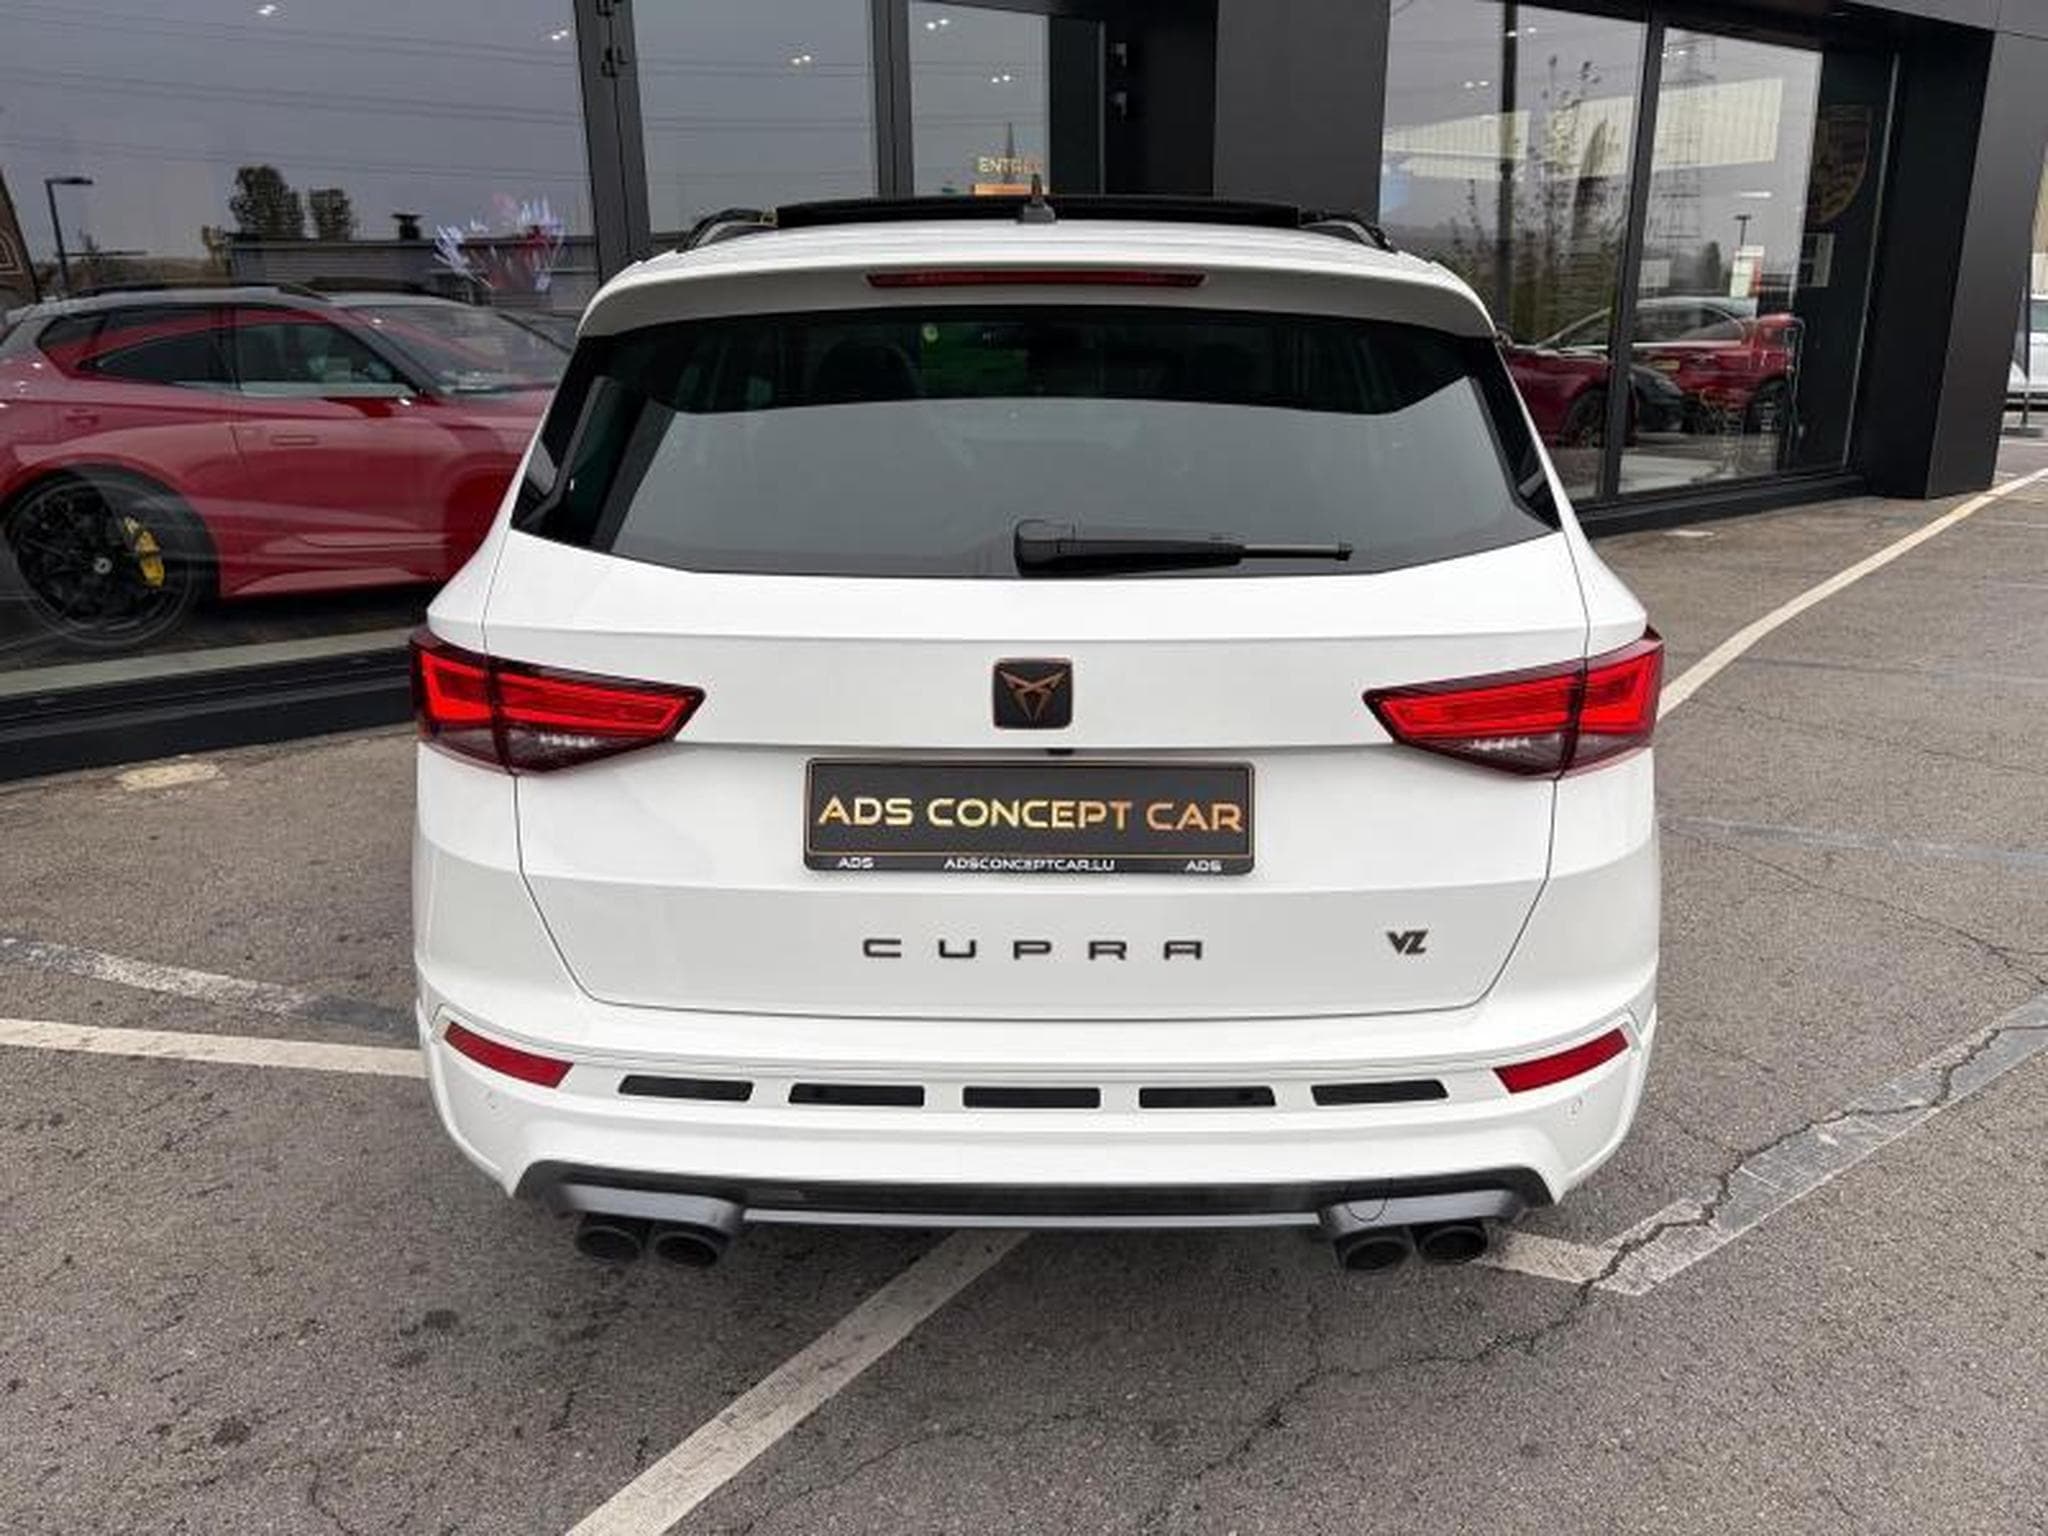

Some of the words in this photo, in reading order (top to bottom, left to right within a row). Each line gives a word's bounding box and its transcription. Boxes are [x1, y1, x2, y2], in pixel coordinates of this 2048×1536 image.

[818, 797, 914, 826] ADS
[927, 798, 1132, 830] CONCEPT
[1146, 803, 1244, 833] CAR
[837, 857, 875, 869] ADS
[943, 858, 1115, 871] ADSCONCEPTCAR.LU
[1185, 860, 1223, 872] ADS
[863, 938, 1203, 960] CUPRA
[1387, 930, 1429, 955] VZ
